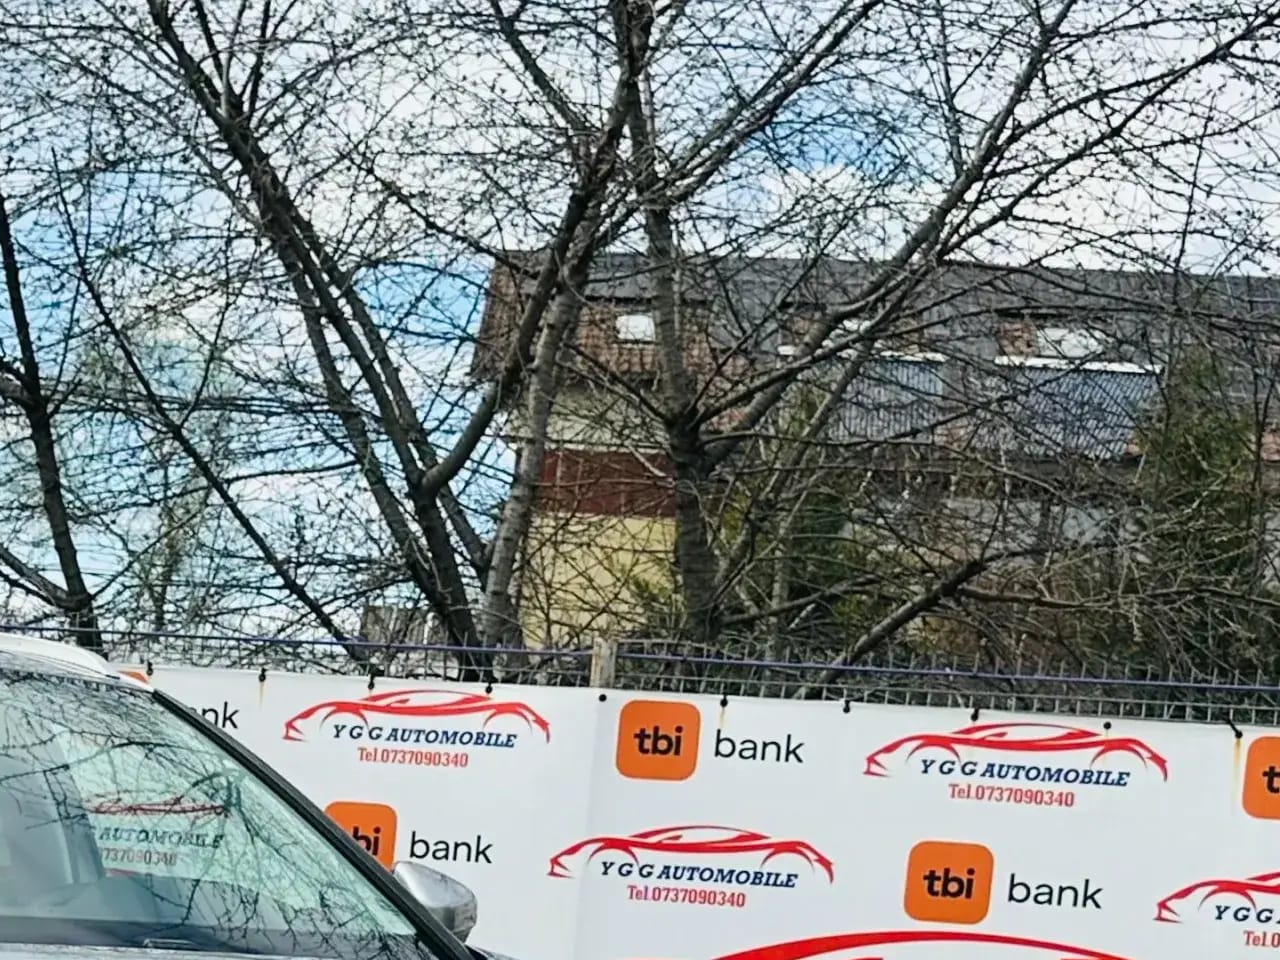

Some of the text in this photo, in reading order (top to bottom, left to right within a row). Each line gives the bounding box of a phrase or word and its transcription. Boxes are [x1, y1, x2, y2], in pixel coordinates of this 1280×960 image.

[386, 728, 517, 748] AUTOMOBILE
[633, 726, 684, 756] tbi
[714, 729, 805, 764] bank
[980, 763, 1130, 787] AUTOMOBILE
[409, 830, 494, 864] bank
[657, 865, 799, 888] AUTOMOBILE
[923, 867, 976, 899] tbi
[1007, 873, 1104, 909] bank
